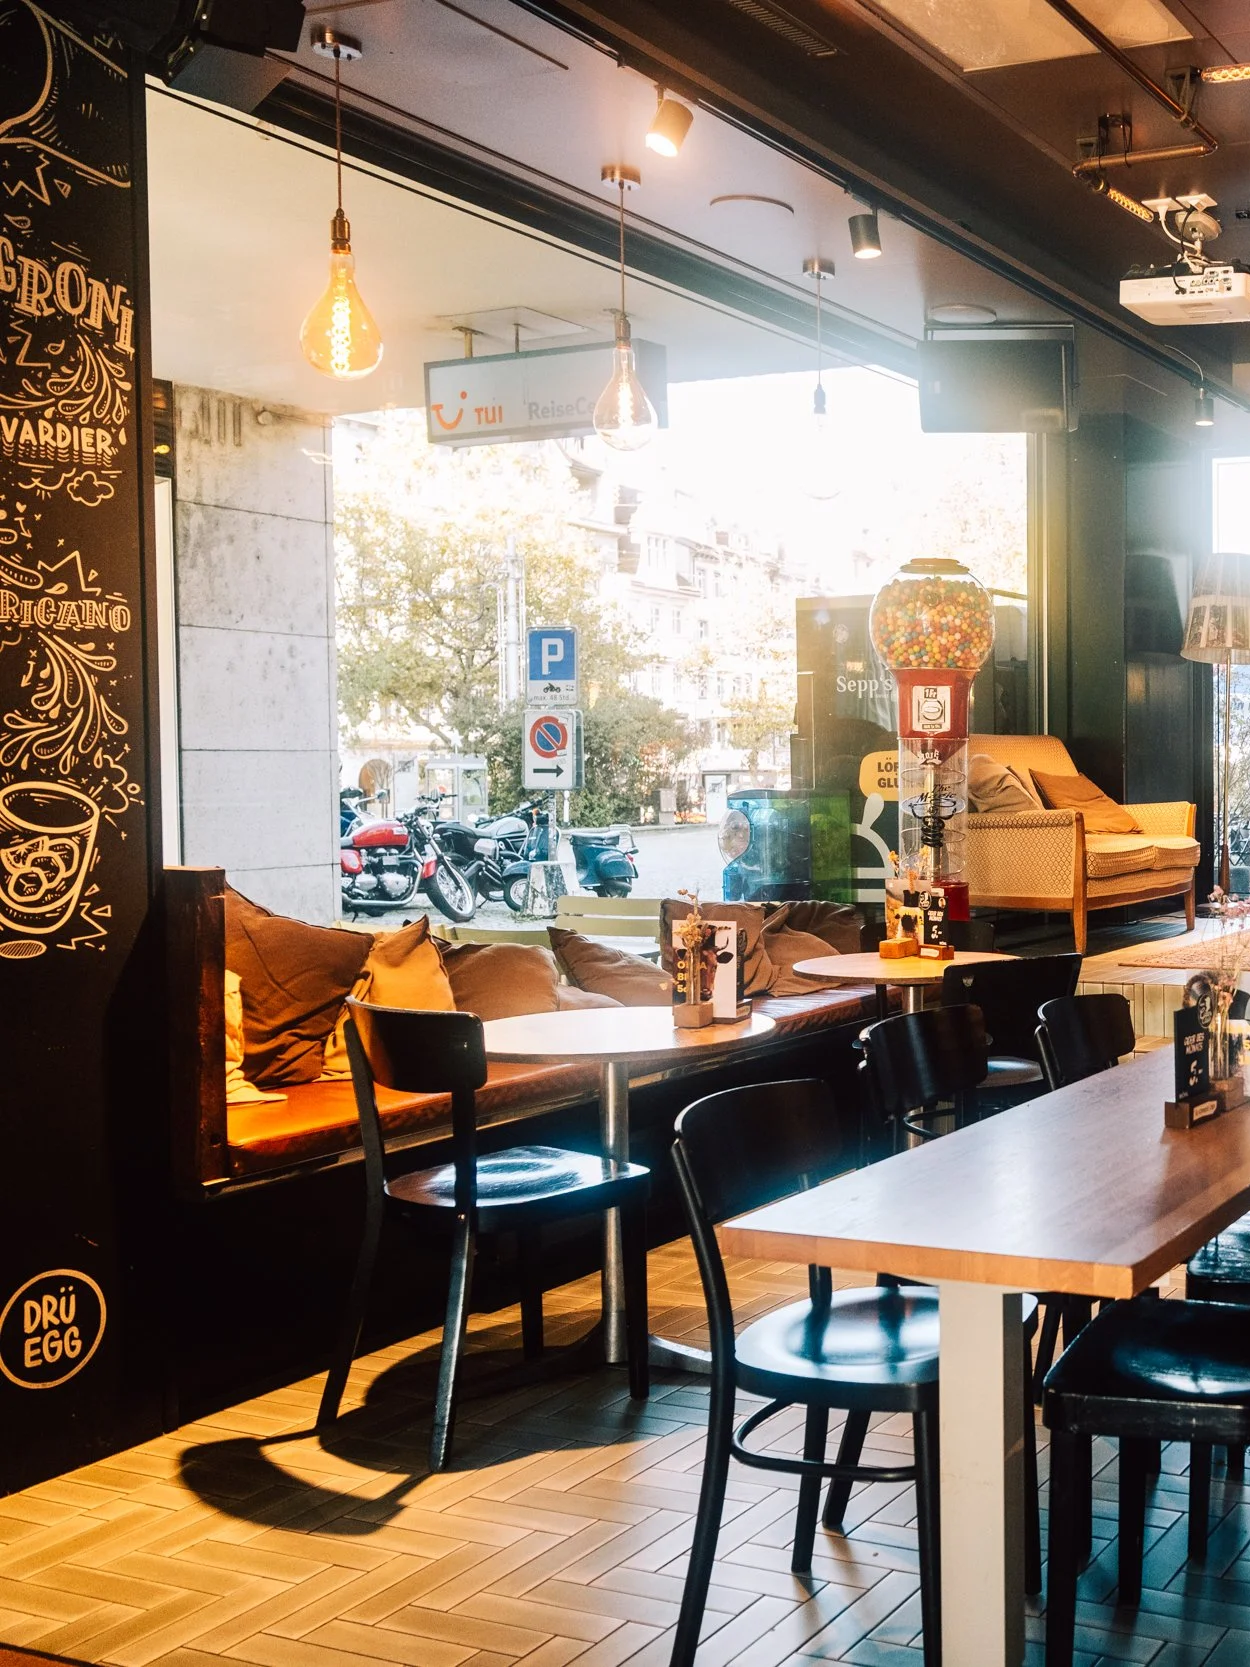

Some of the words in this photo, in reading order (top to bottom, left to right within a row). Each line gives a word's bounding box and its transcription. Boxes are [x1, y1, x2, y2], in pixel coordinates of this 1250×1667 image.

[1, 415, 113, 456] VARDIER
[474, 405, 503, 425] TUI
[541, 638, 564, 675] P
[24, 1285, 76, 1334] DRÜ
[25, 1326, 82, 1368] EGG
